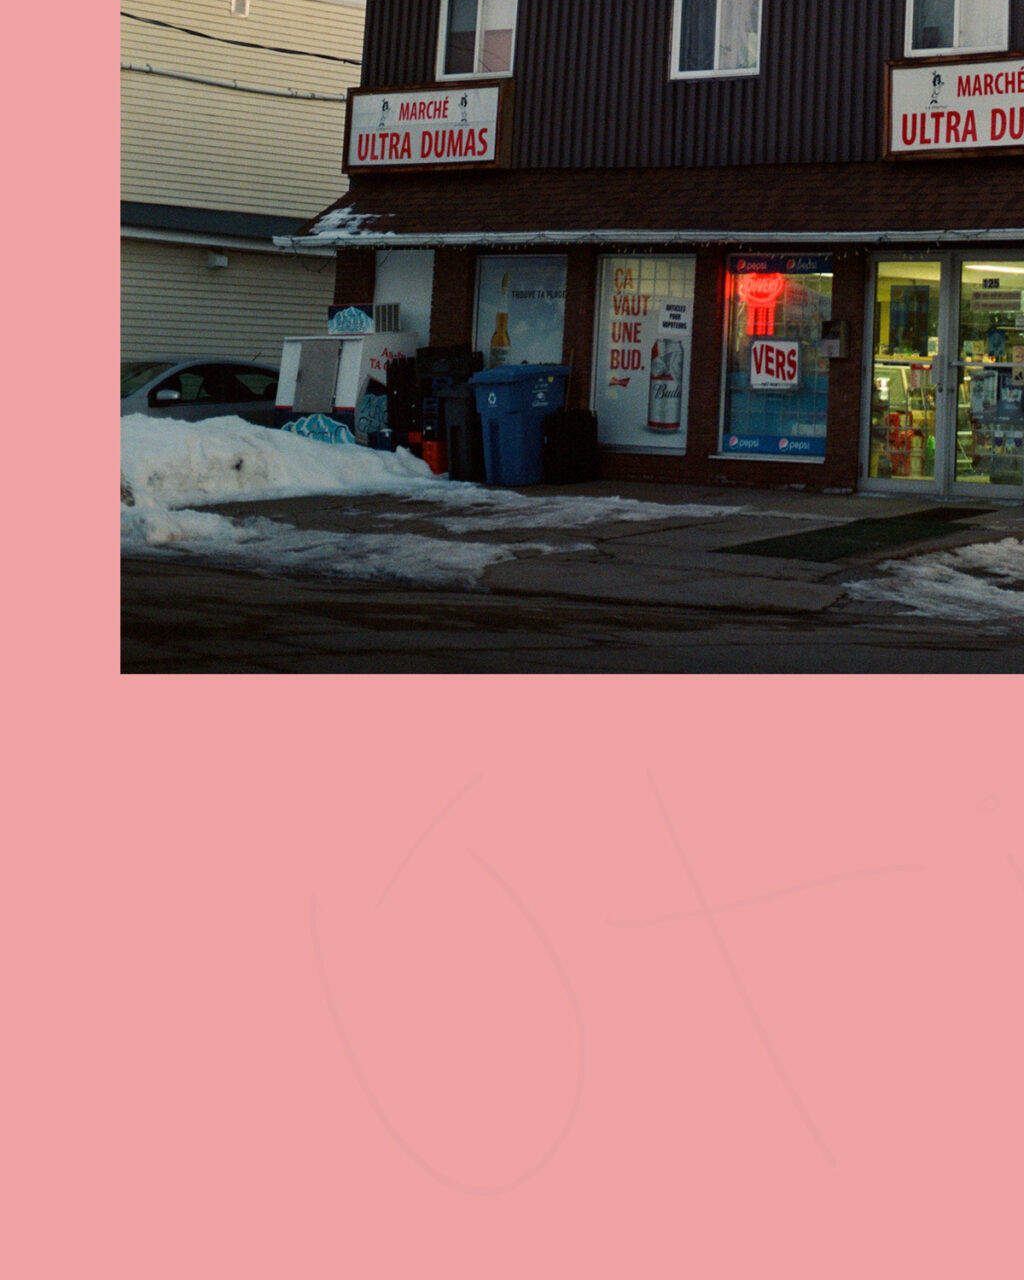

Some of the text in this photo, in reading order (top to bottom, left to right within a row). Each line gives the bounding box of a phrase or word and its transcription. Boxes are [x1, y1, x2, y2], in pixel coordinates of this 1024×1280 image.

[398, 96, 449, 121] MARCHÉ
[901, 109, 978, 146] ULTRA
[357, 127, 489, 161] ULTRA DUMAS
[746, 261, 767, 271] pepsi
[614, 268, 633, 295] ÇA
[983, 278, 1000, 289] 125
[613, 295, 651, 317] VAUT
[611, 322, 642, 344] UNE
[610, 349, 645, 371] BUD.
[752, 343, 797, 382] VERS
[739, 438, 760, 448] pepsi
[789, 440, 810, 450] pepsi
